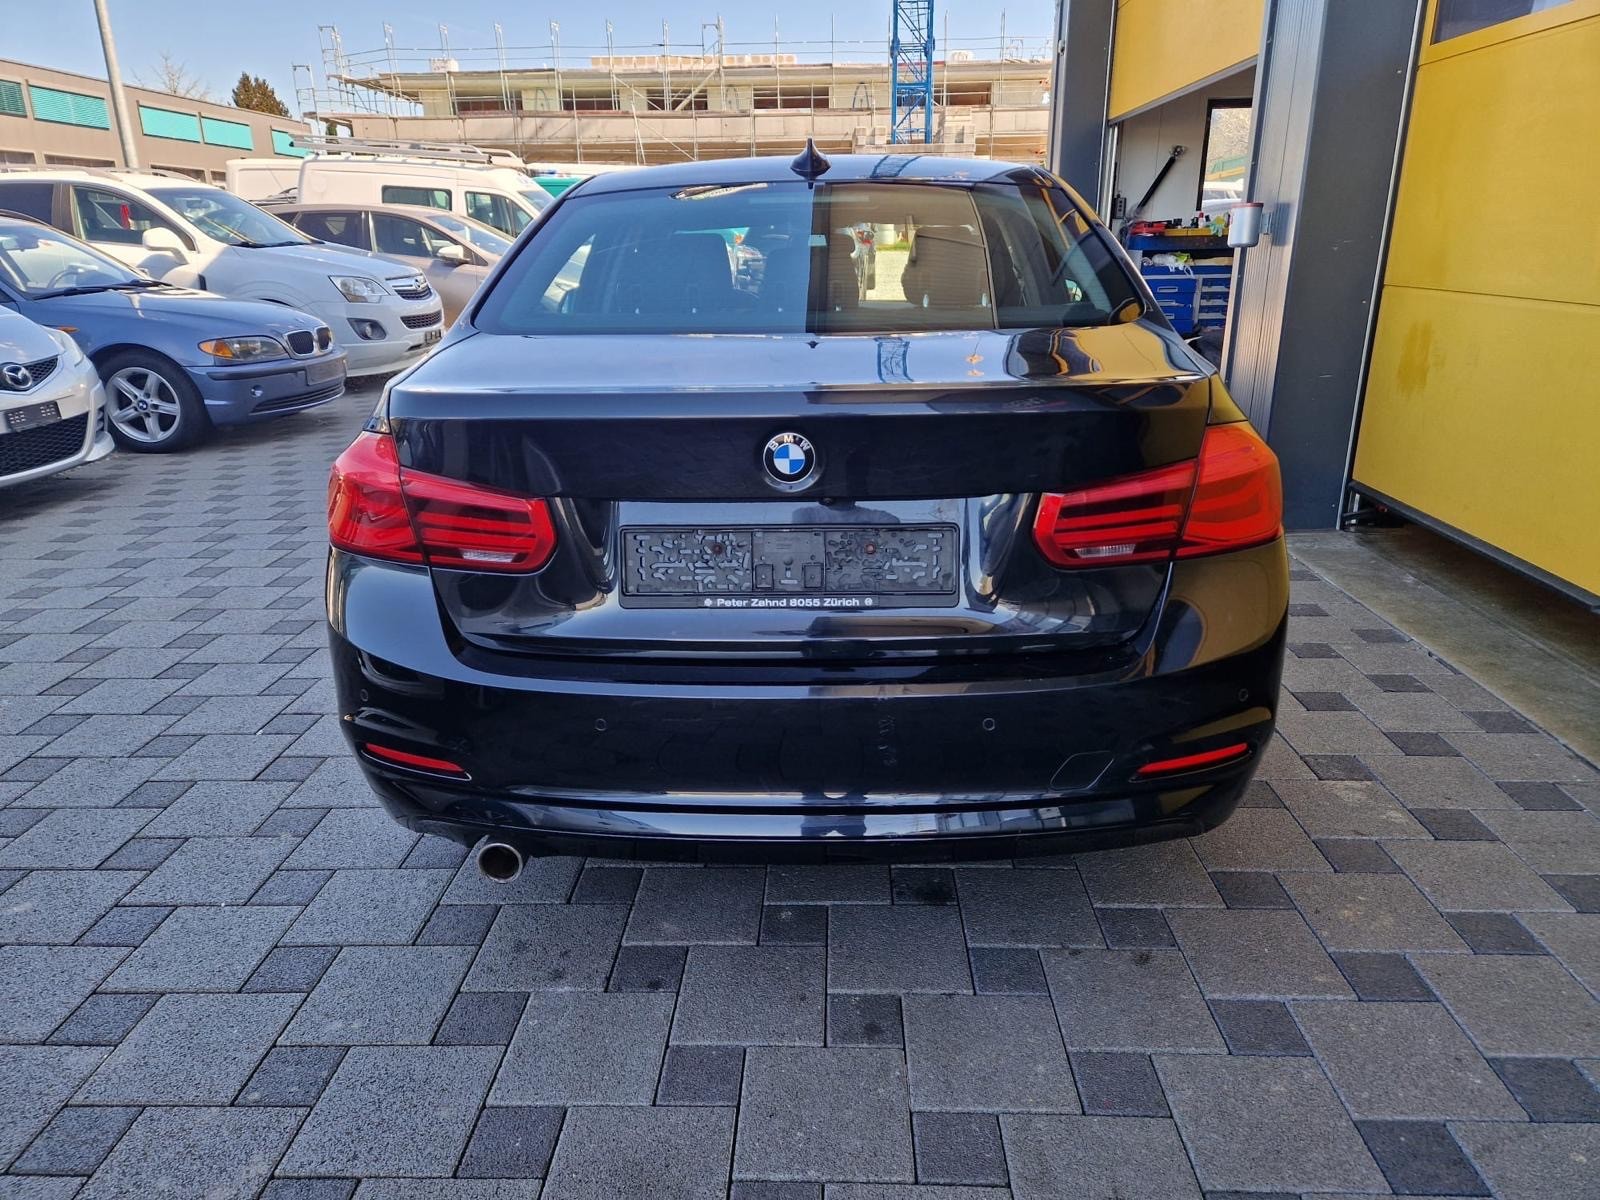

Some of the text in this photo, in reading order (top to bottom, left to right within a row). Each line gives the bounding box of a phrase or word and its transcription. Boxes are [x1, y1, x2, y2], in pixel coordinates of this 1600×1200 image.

[768, 434, 810, 452] BMW
[716, 597, 860, 607] Peter Zahnd 8055 Zürich
